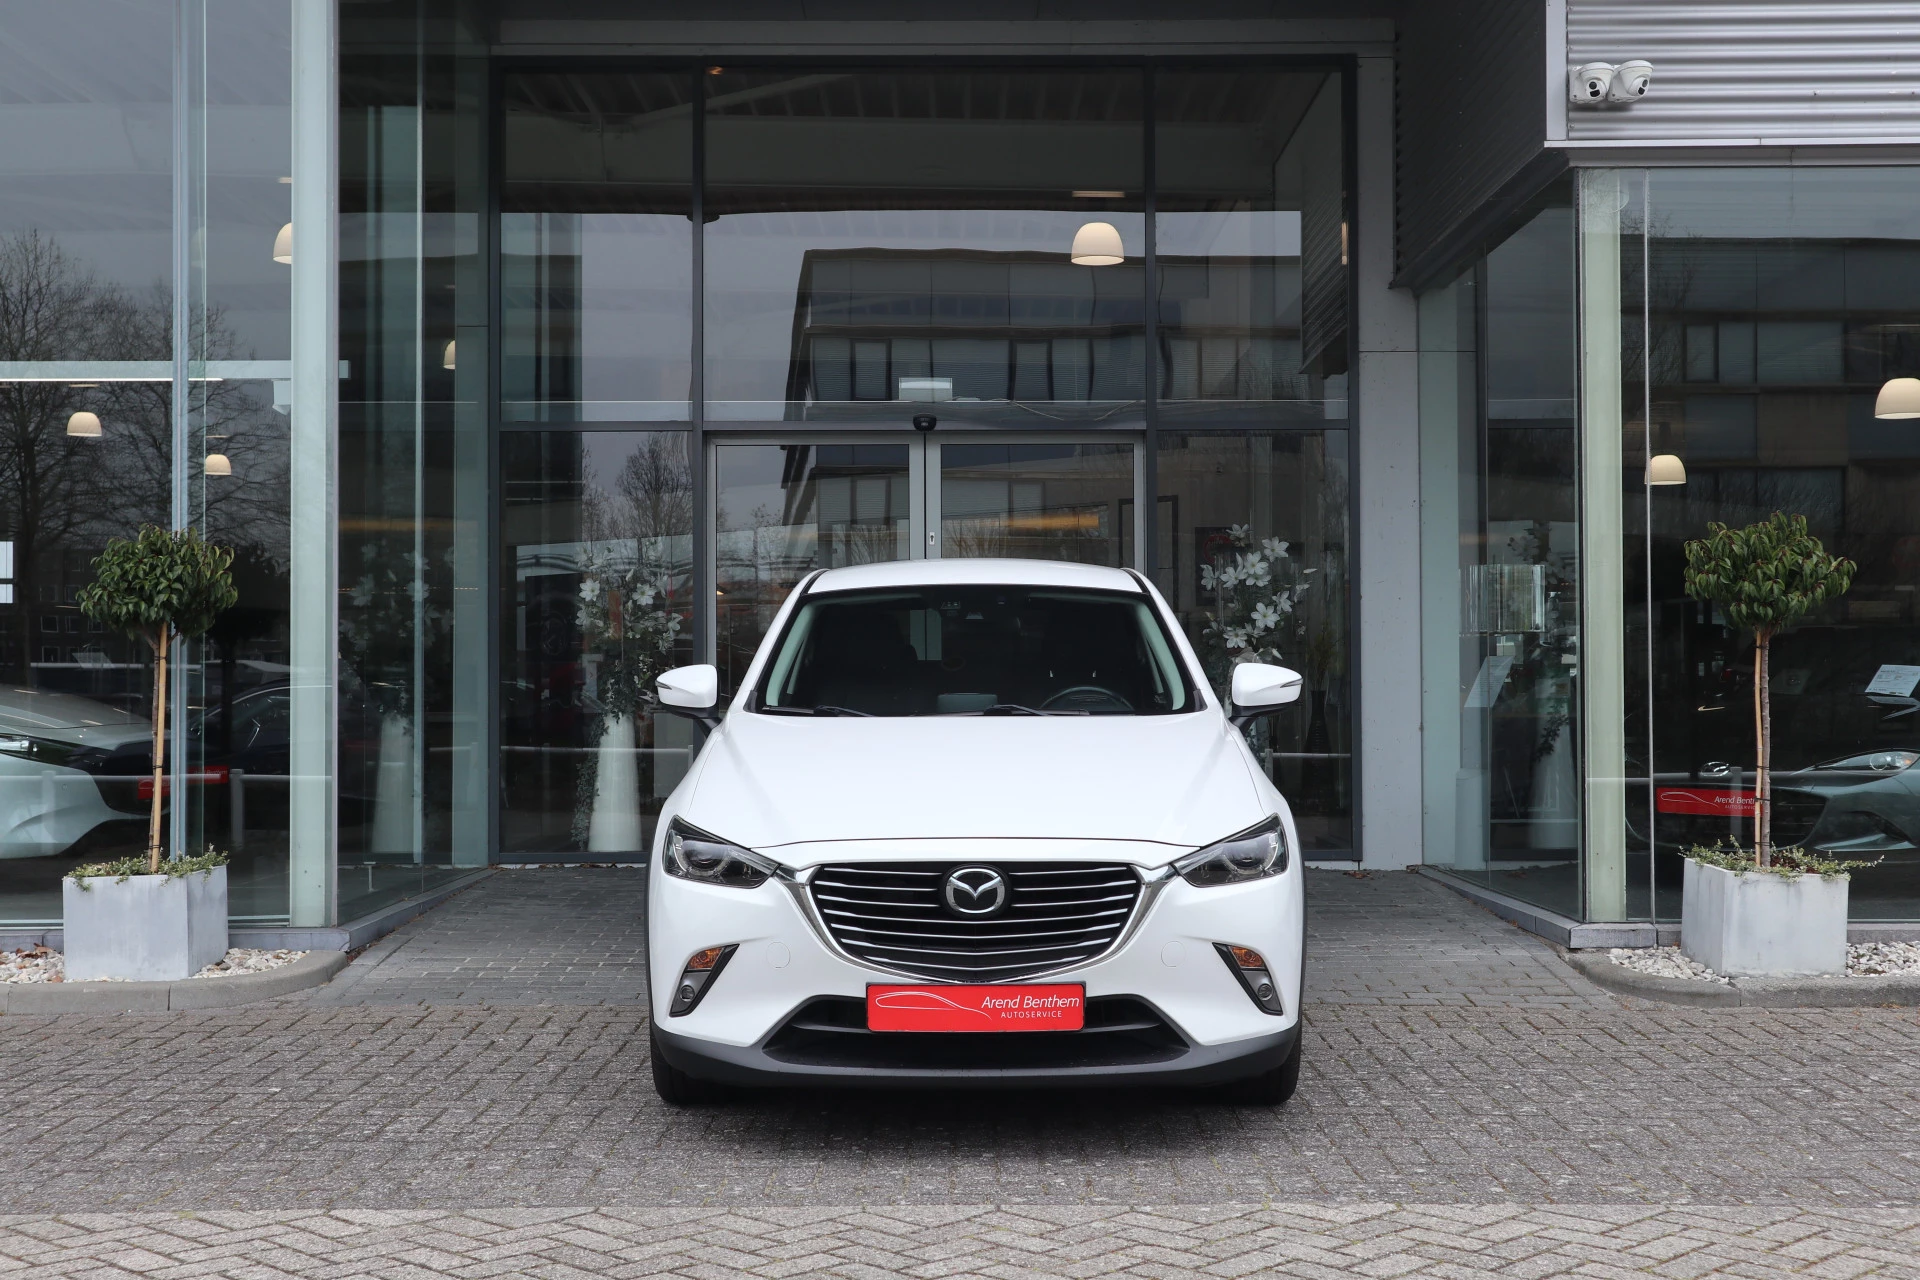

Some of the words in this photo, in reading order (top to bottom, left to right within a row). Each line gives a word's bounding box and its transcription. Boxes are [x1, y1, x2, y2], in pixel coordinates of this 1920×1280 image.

[1714, 796, 1736, 804] Arend
[981, 994, 1021, 1009] Arend
[1023, 994, 1080, 1009] Benthem
[1001, 1010, 1062, 1019] AUTOSERVICE
